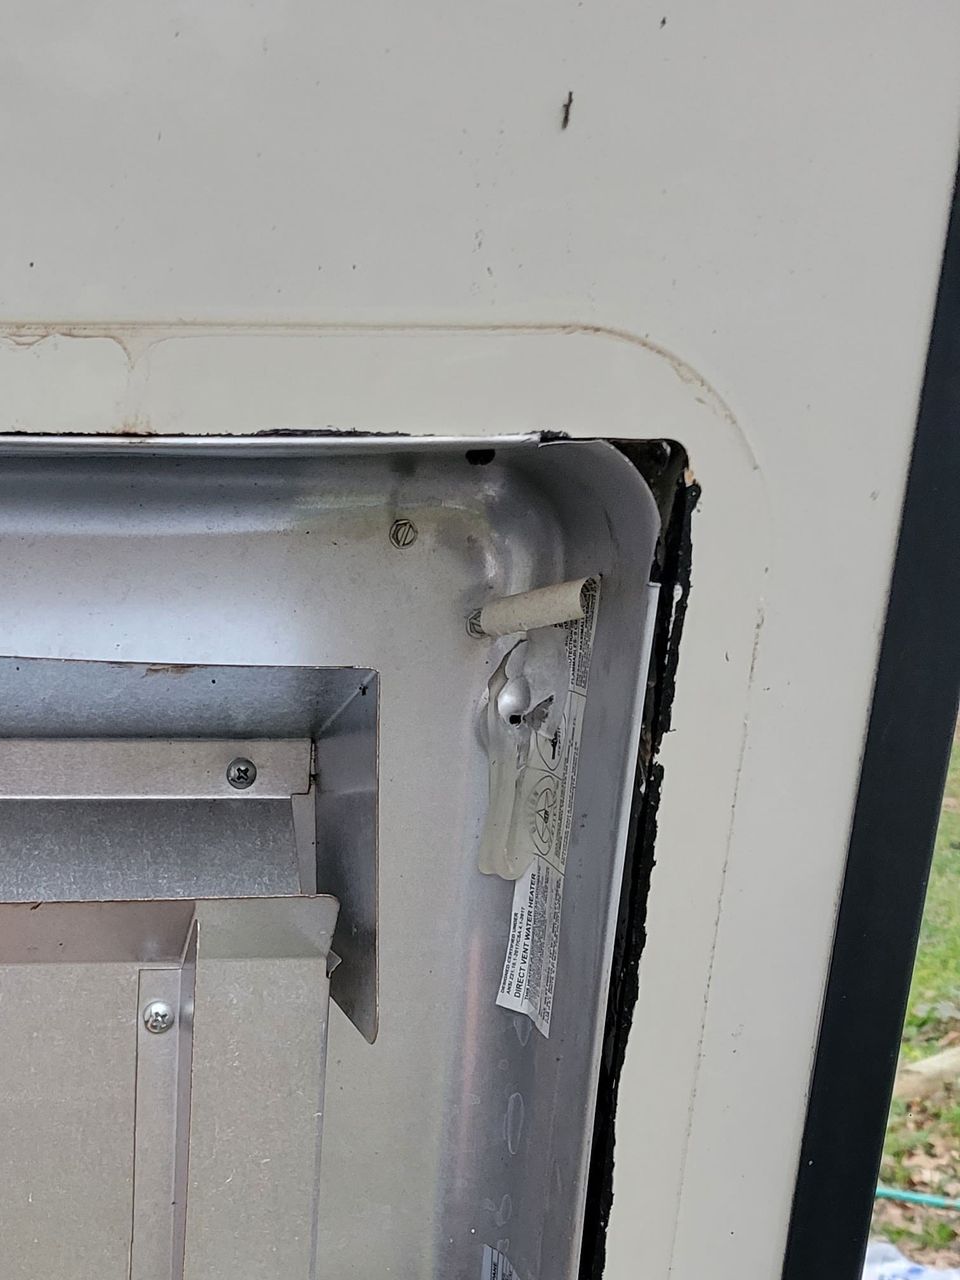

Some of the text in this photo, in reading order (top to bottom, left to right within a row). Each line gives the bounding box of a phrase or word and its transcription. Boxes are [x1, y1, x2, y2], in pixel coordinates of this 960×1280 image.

[514, 873, 537, 998] DIRECT VENT WATER HEATER
